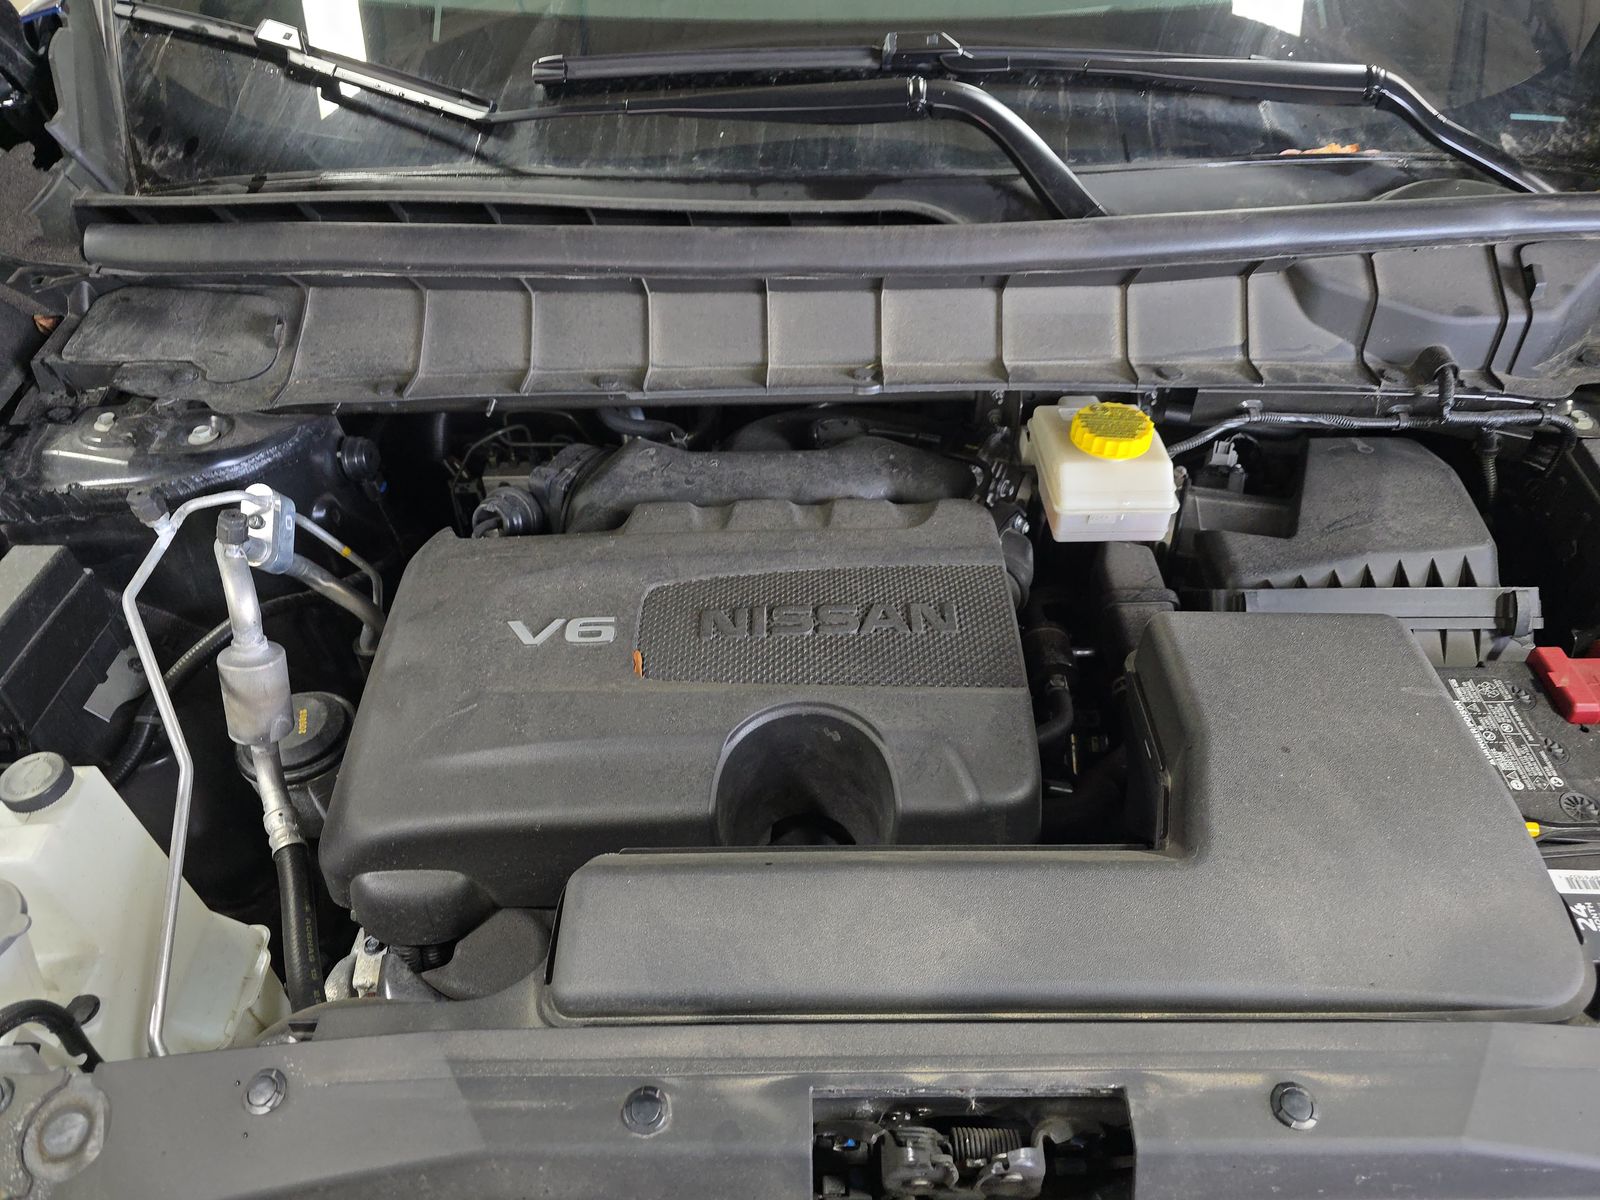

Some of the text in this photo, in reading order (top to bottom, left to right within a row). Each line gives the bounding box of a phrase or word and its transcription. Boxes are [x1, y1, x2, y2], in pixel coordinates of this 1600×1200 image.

[507, 617, 617, 647] V6
[700, 603, 958, 638] NISSAN
[1570, 902, 1598, 932] 24
